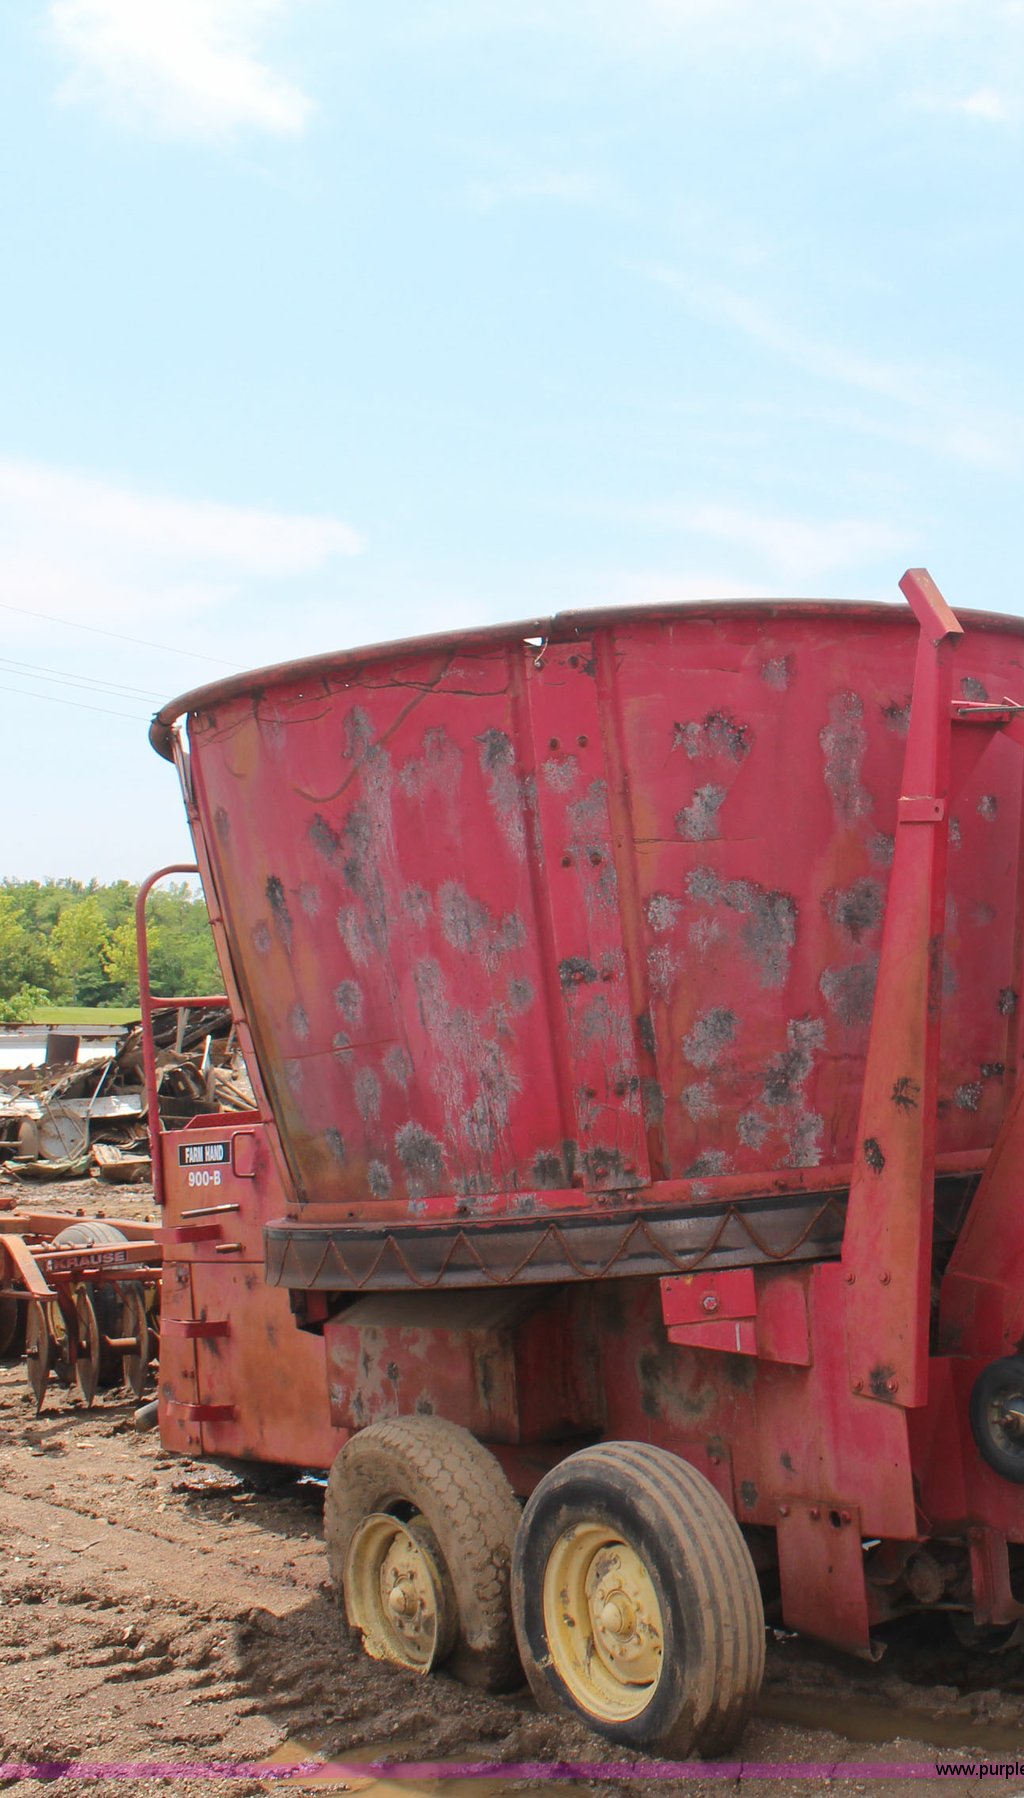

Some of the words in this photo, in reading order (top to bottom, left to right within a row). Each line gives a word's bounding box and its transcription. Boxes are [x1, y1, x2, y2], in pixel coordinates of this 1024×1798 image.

[185, 1146, 204, 1163] FARM
[204, 1145, 224, 1162] HAND
[188, 1170, 222, 1187] 900-B
[53, 1251, 126, 1270] KRAUSE
